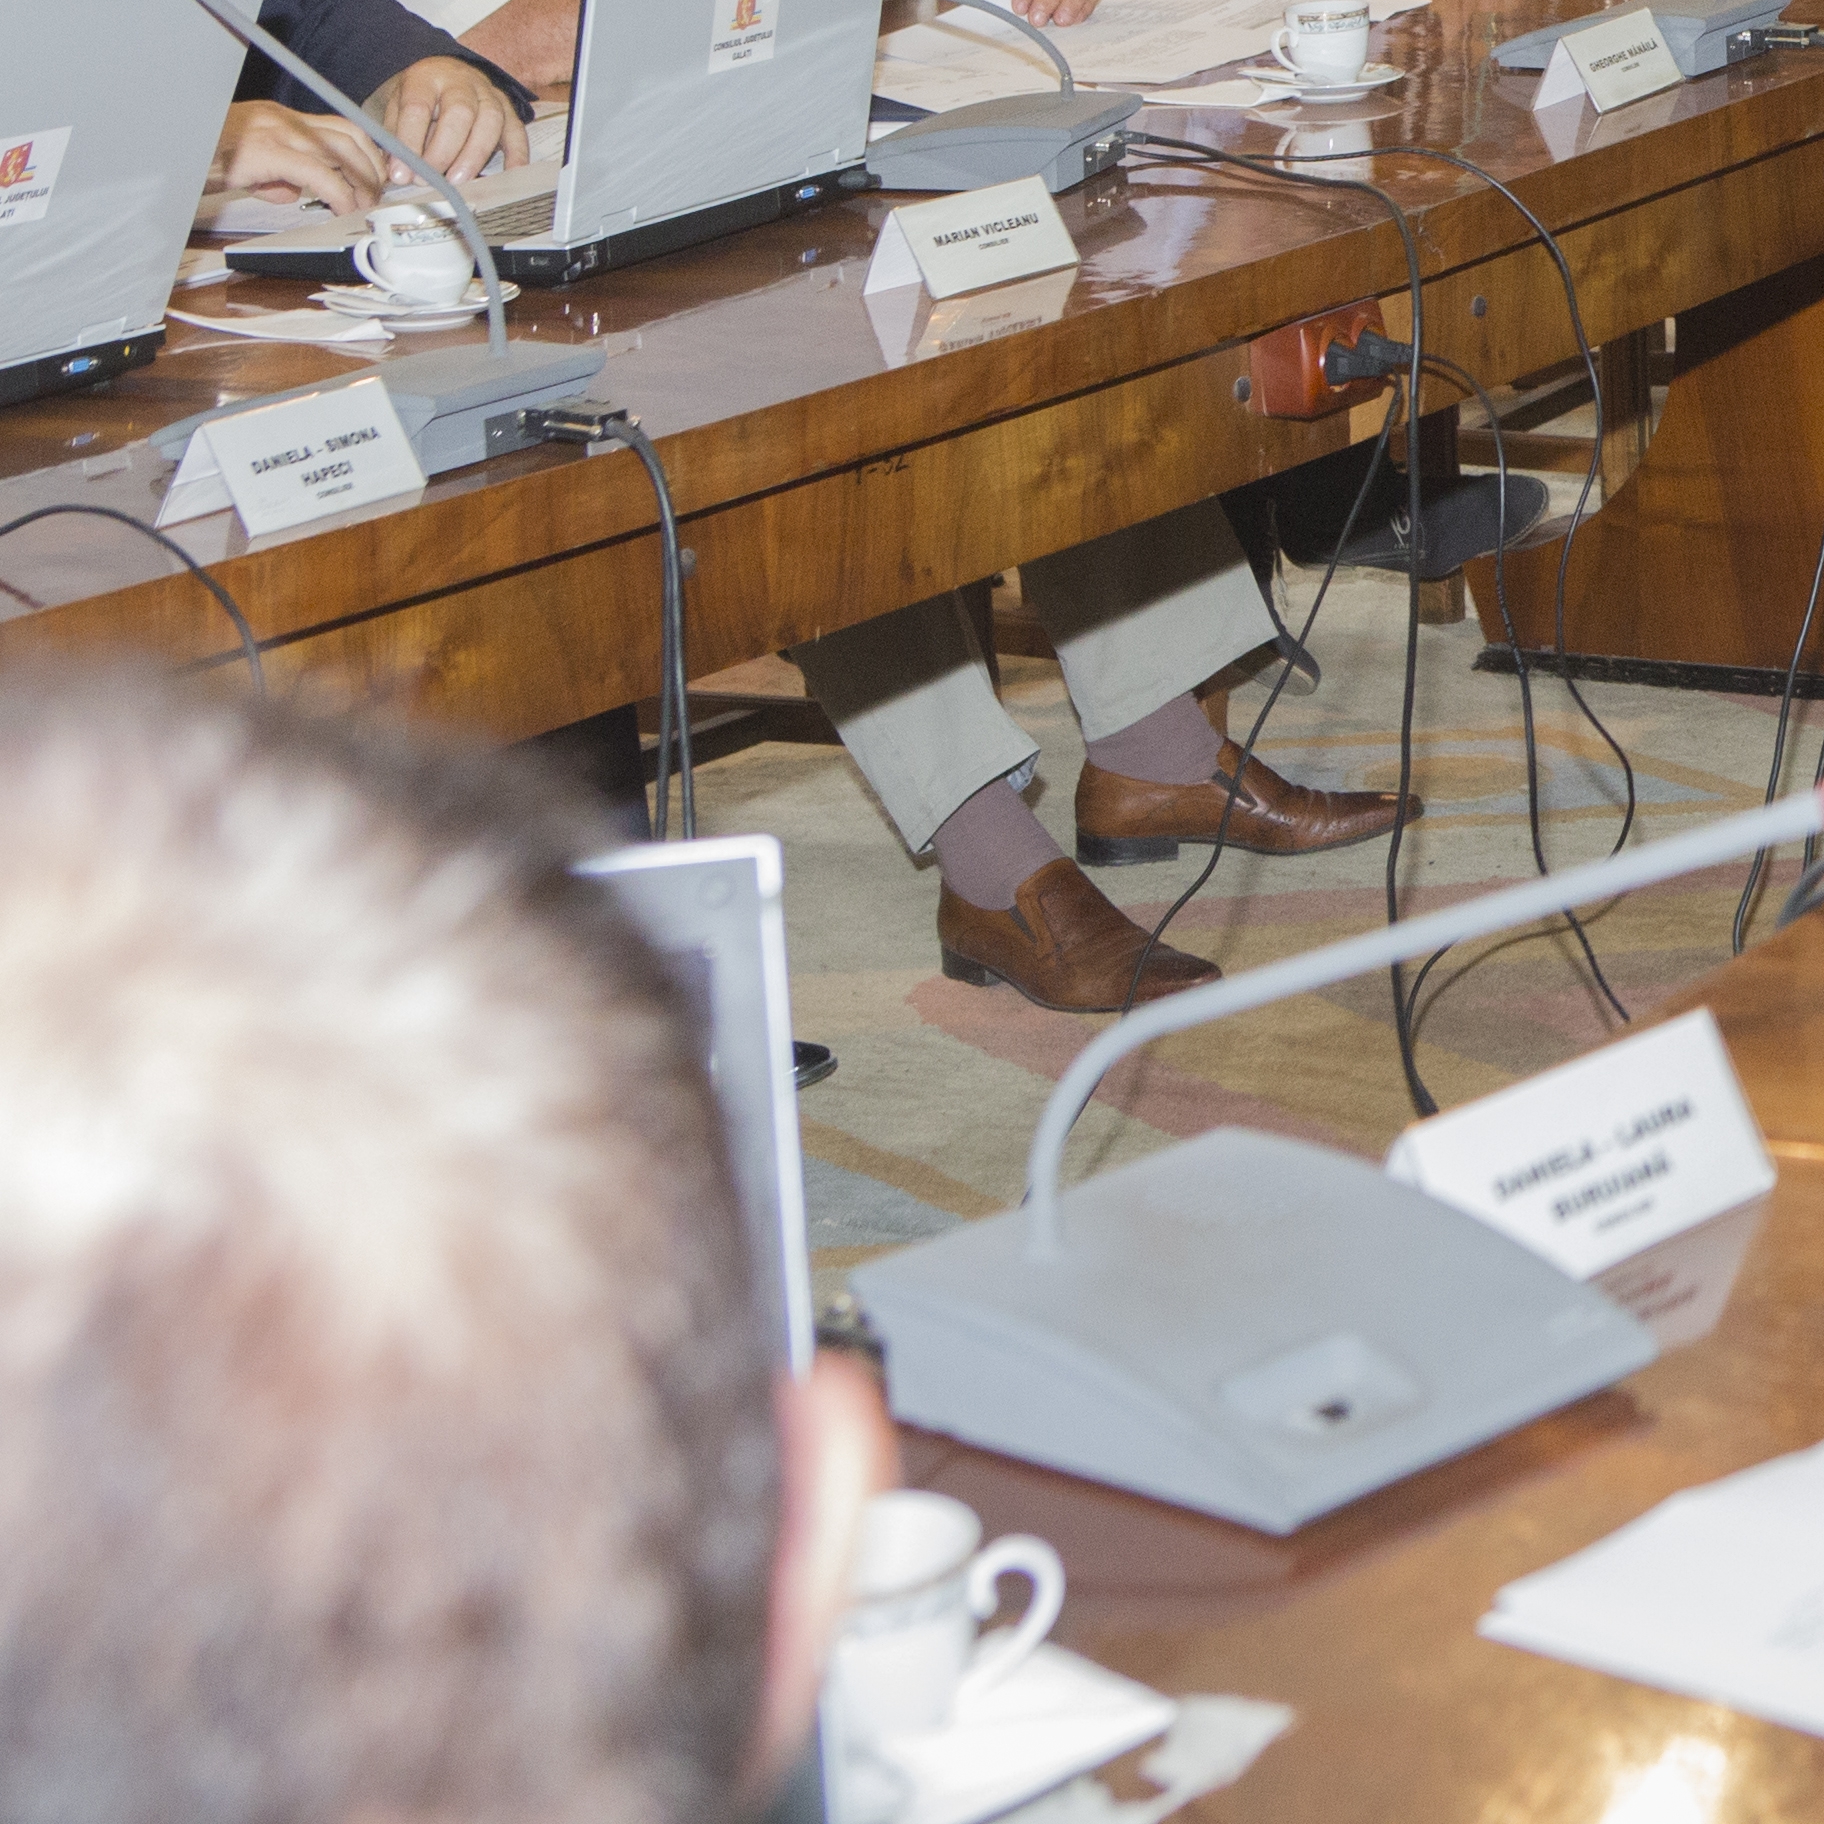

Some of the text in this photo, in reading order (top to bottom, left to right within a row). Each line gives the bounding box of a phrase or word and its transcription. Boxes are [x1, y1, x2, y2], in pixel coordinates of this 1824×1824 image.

[713, 38, 742, 52] CONSILIUL
[1589, 50, 1629, 73] GHEORGHE
[933, 212, 1039, 247] MARIAN VICLEANU
[251, 445, 314, 475] DANIELA
[325, 426, 381, 453] SIMONA
[301, 459, 354, 487] HAPECI
[1494, 1136, 1596, 1206] DANIELA
[1614, 1094, 1697, 1150] LAURA
